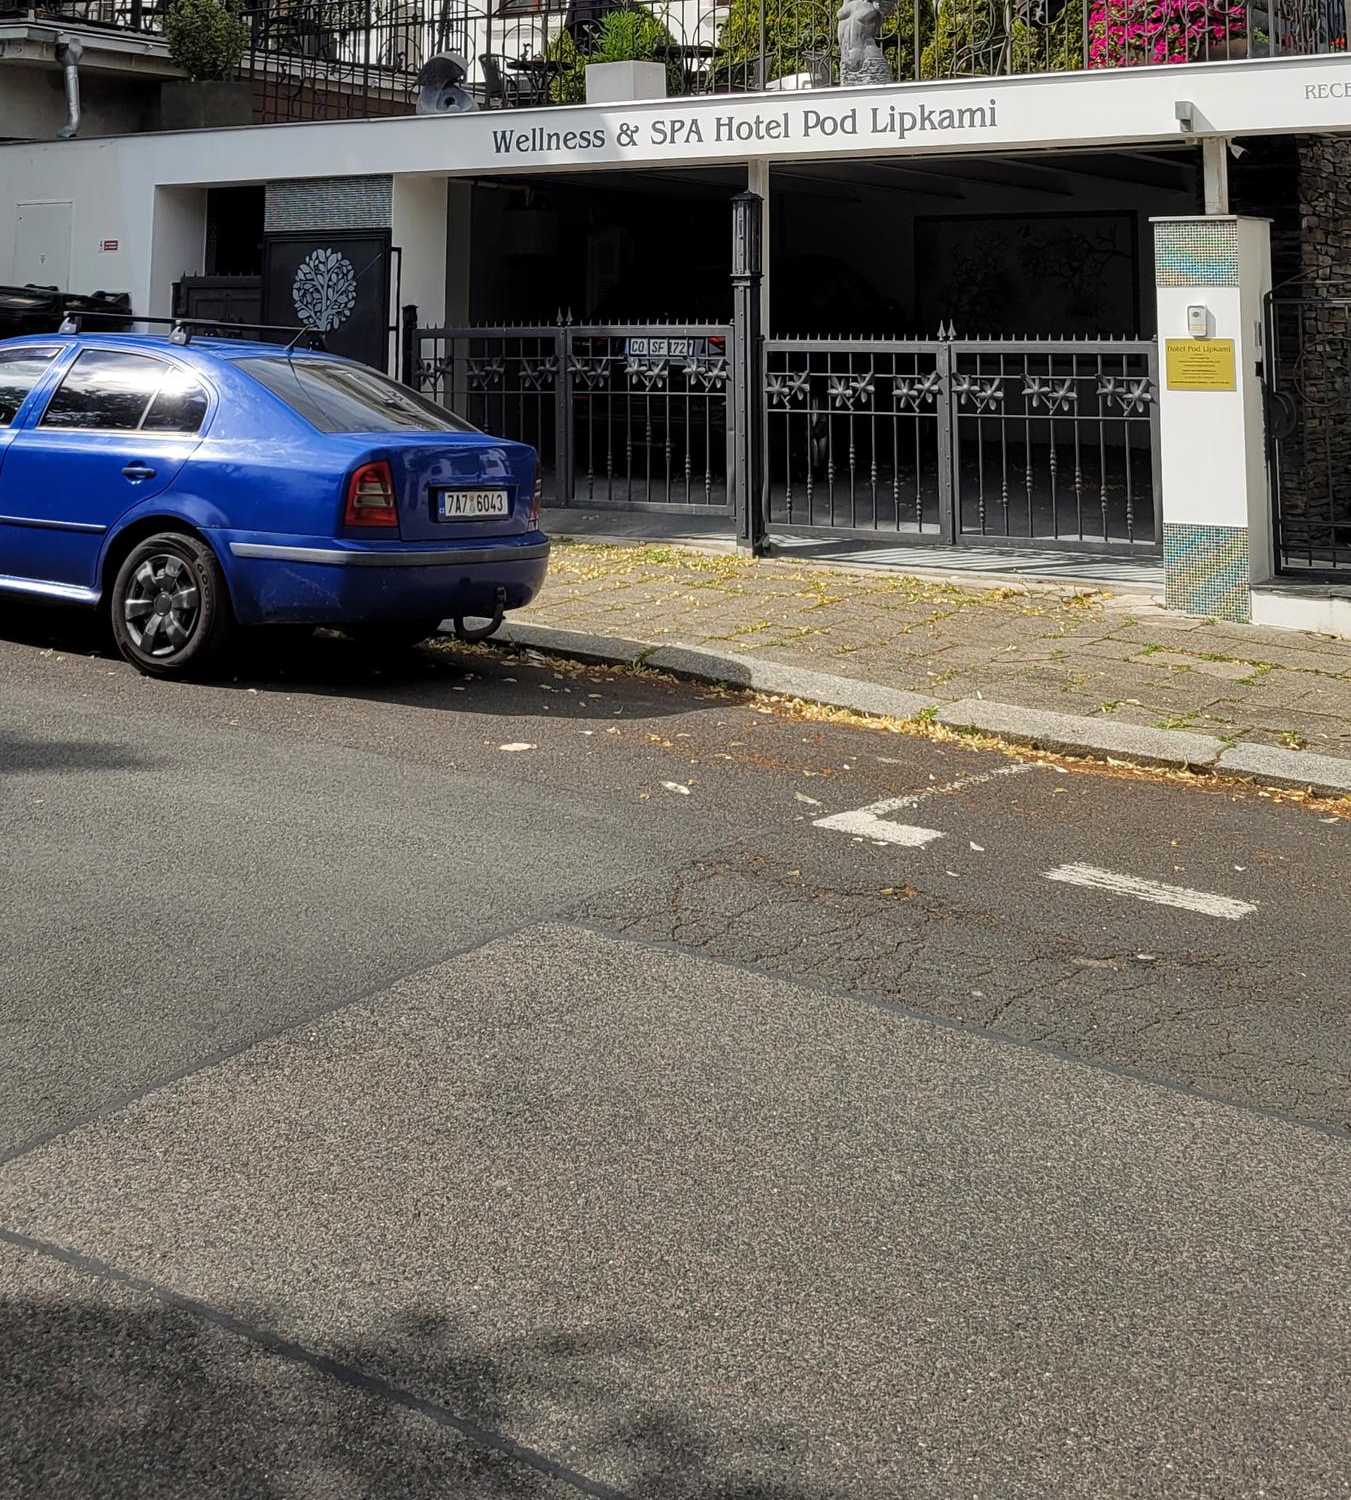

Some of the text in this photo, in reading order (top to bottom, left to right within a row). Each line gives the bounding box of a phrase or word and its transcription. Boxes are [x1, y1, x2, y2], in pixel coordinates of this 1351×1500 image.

[492, 99, 997, 153] Wellness & SPA Hotel Pod Lipkami
[447, 494, 503, 513] 7A7 6043
